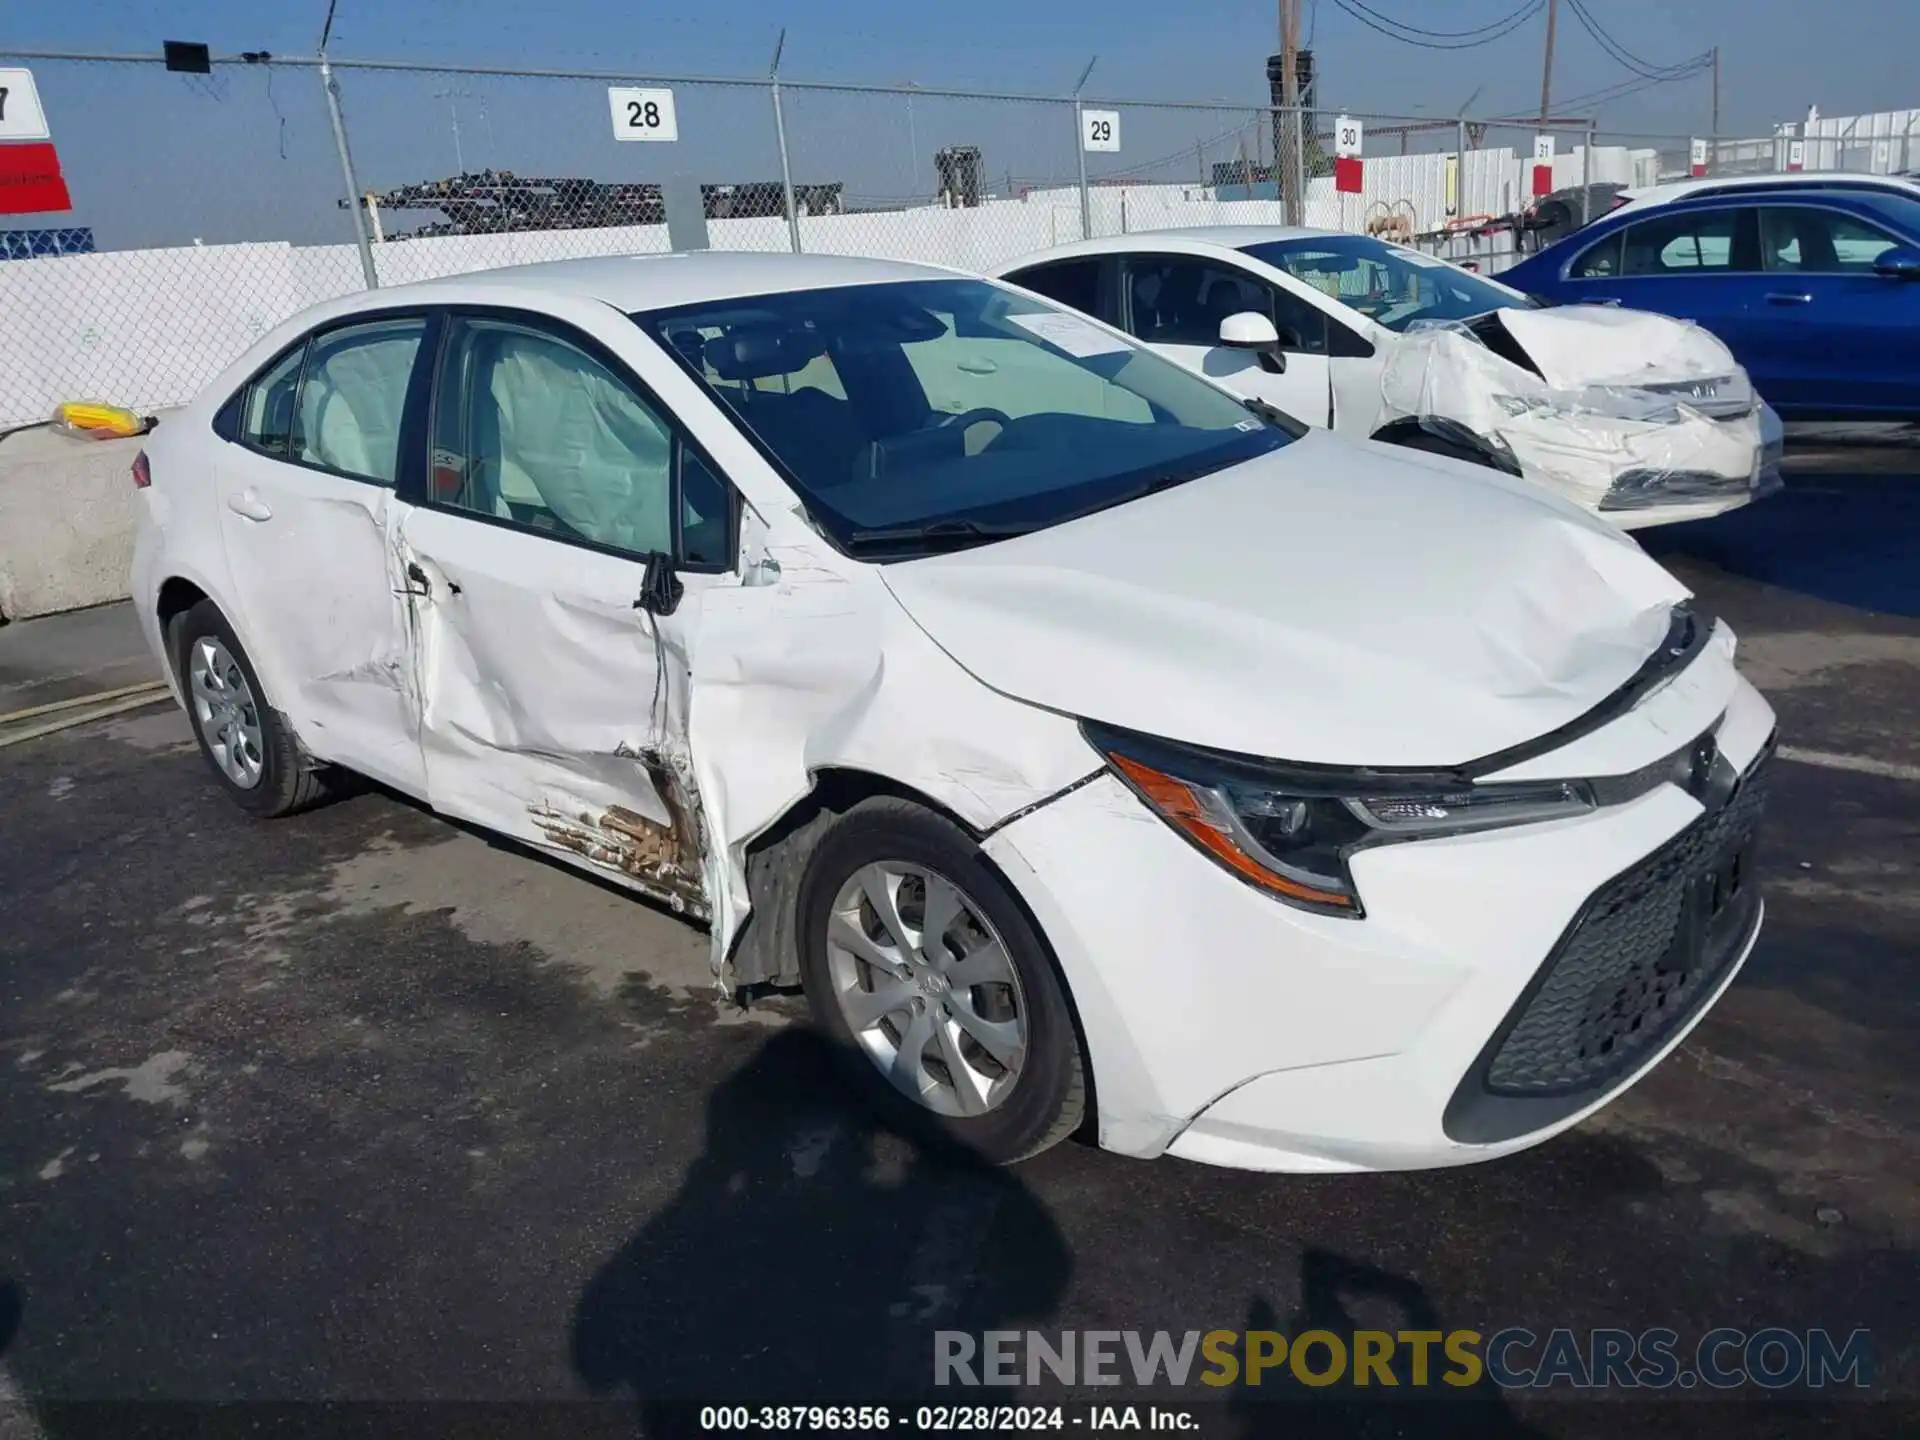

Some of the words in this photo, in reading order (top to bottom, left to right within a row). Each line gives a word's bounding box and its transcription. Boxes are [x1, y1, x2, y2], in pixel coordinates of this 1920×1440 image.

[627, 101, 660, 128] 28
[1091, 120, 1111, 141] 29
[1342, 128, 1356, 145] 30
[1539, 143, 1549, 158] 31
